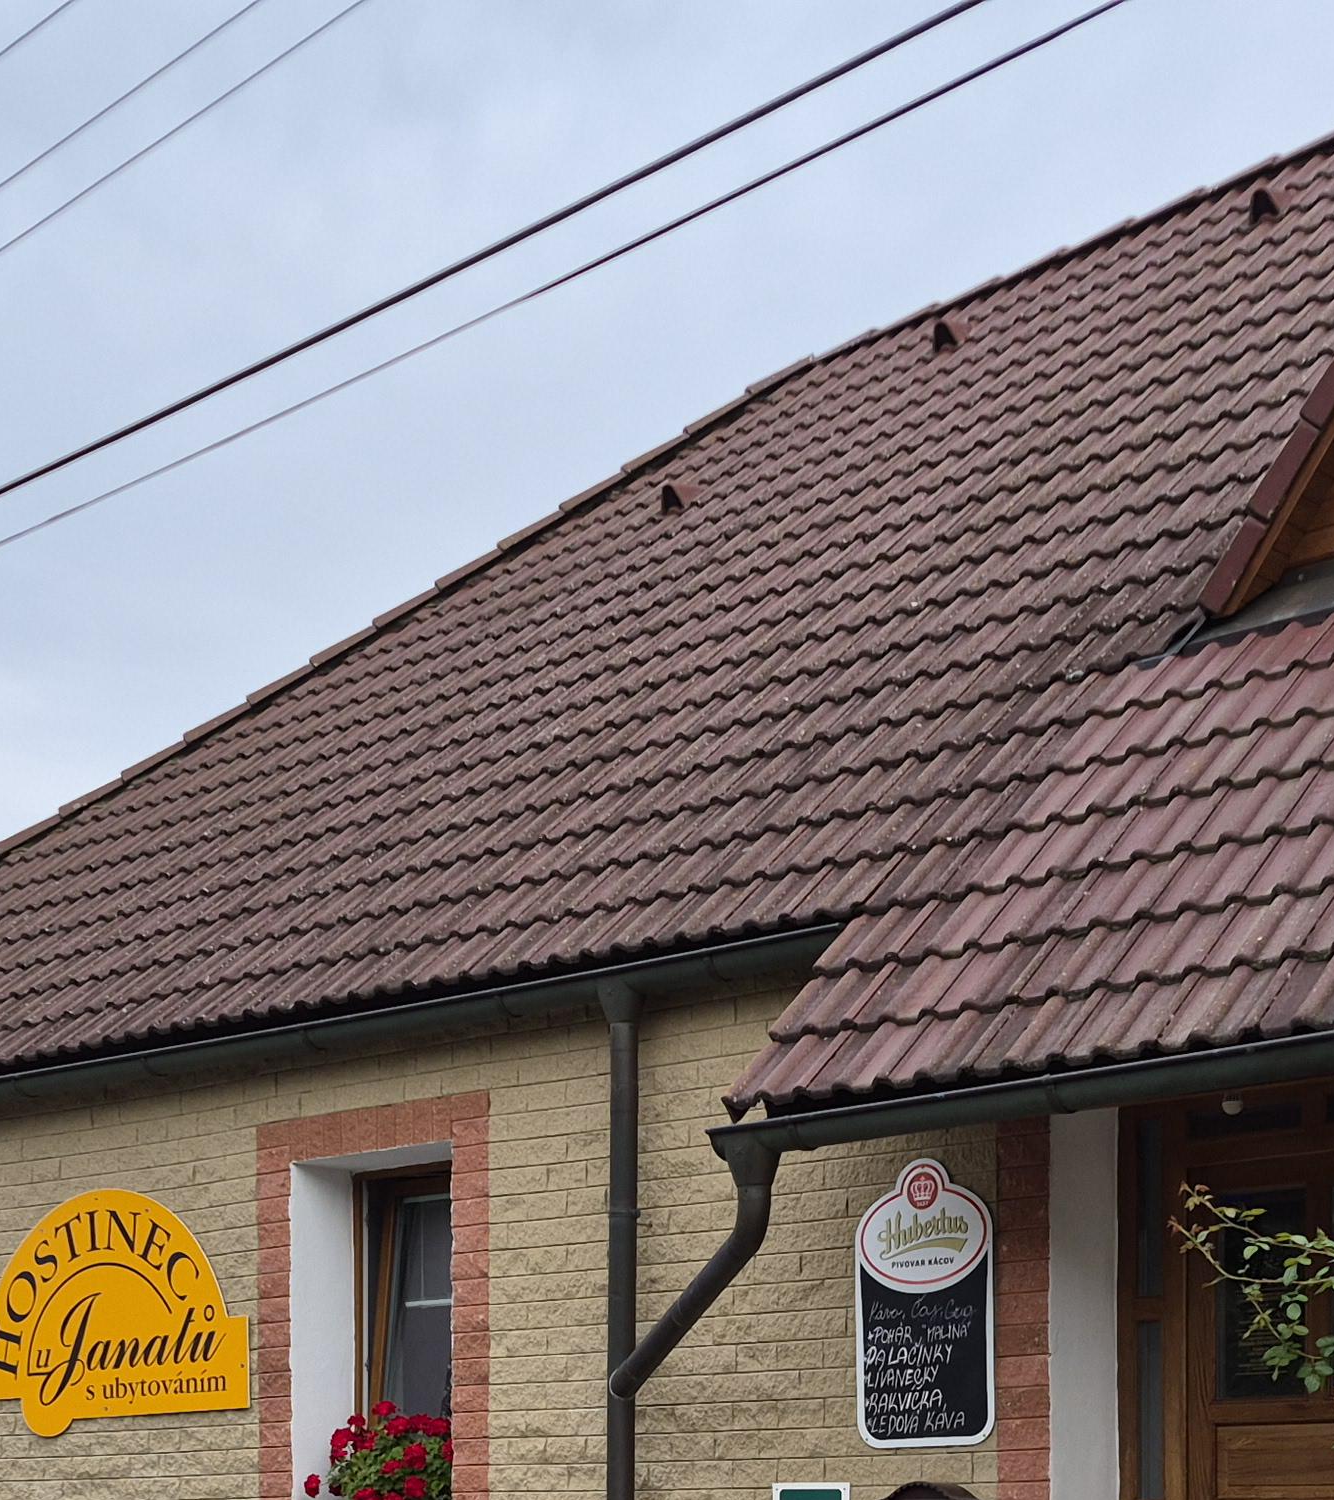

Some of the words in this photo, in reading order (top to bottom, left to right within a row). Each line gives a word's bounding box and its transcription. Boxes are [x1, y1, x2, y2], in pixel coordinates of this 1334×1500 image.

[877, 1207, 968, 1254] Hubertus
[891, 1259, 925, 1269] PIVOVAR
[928, 1256, 954, 1266] KÁCOV
[36, 1349, 52, 1369] u
[39, 1292, 227, 1406] Janatů
[86, 1384, 95, 1400] s
[102, 1369, 227, 1404] ubytováním
